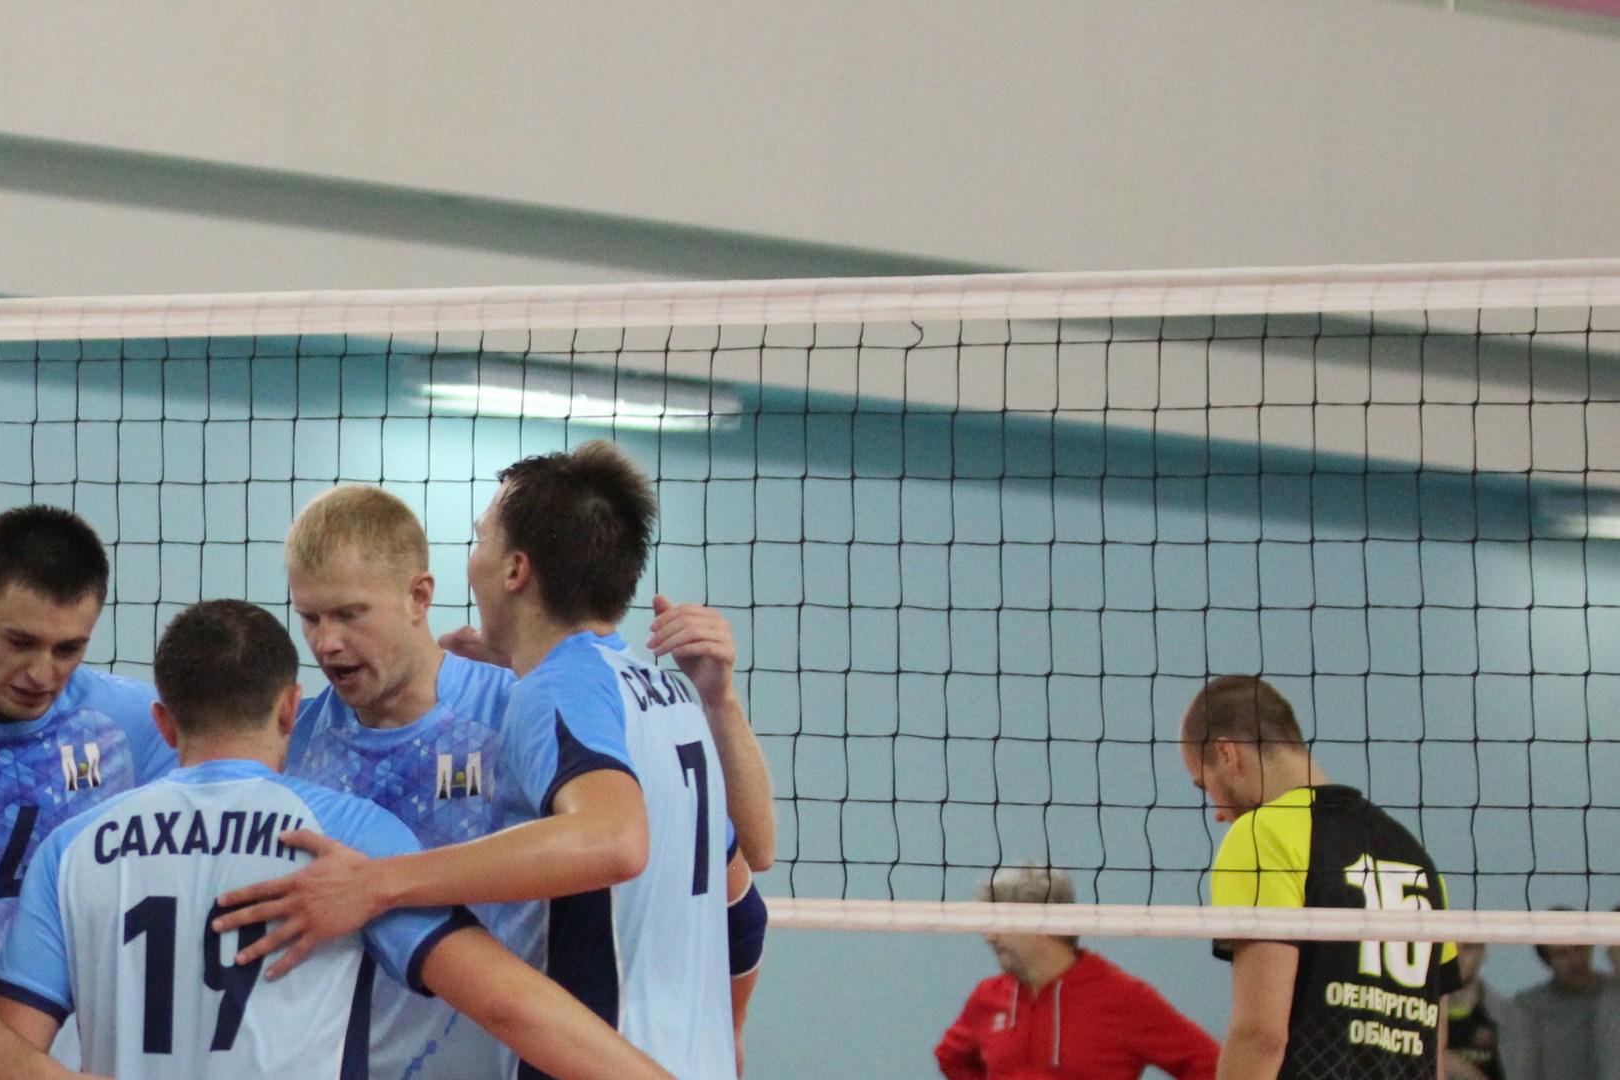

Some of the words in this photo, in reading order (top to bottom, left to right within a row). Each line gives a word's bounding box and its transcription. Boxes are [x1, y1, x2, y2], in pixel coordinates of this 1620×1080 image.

[93, 810, 304, 865] САХАЛИН
[676, 740, 709, 896] 7
[123, 895, 267, 1055] 19
[1343, 852, 1433, 989] 15
